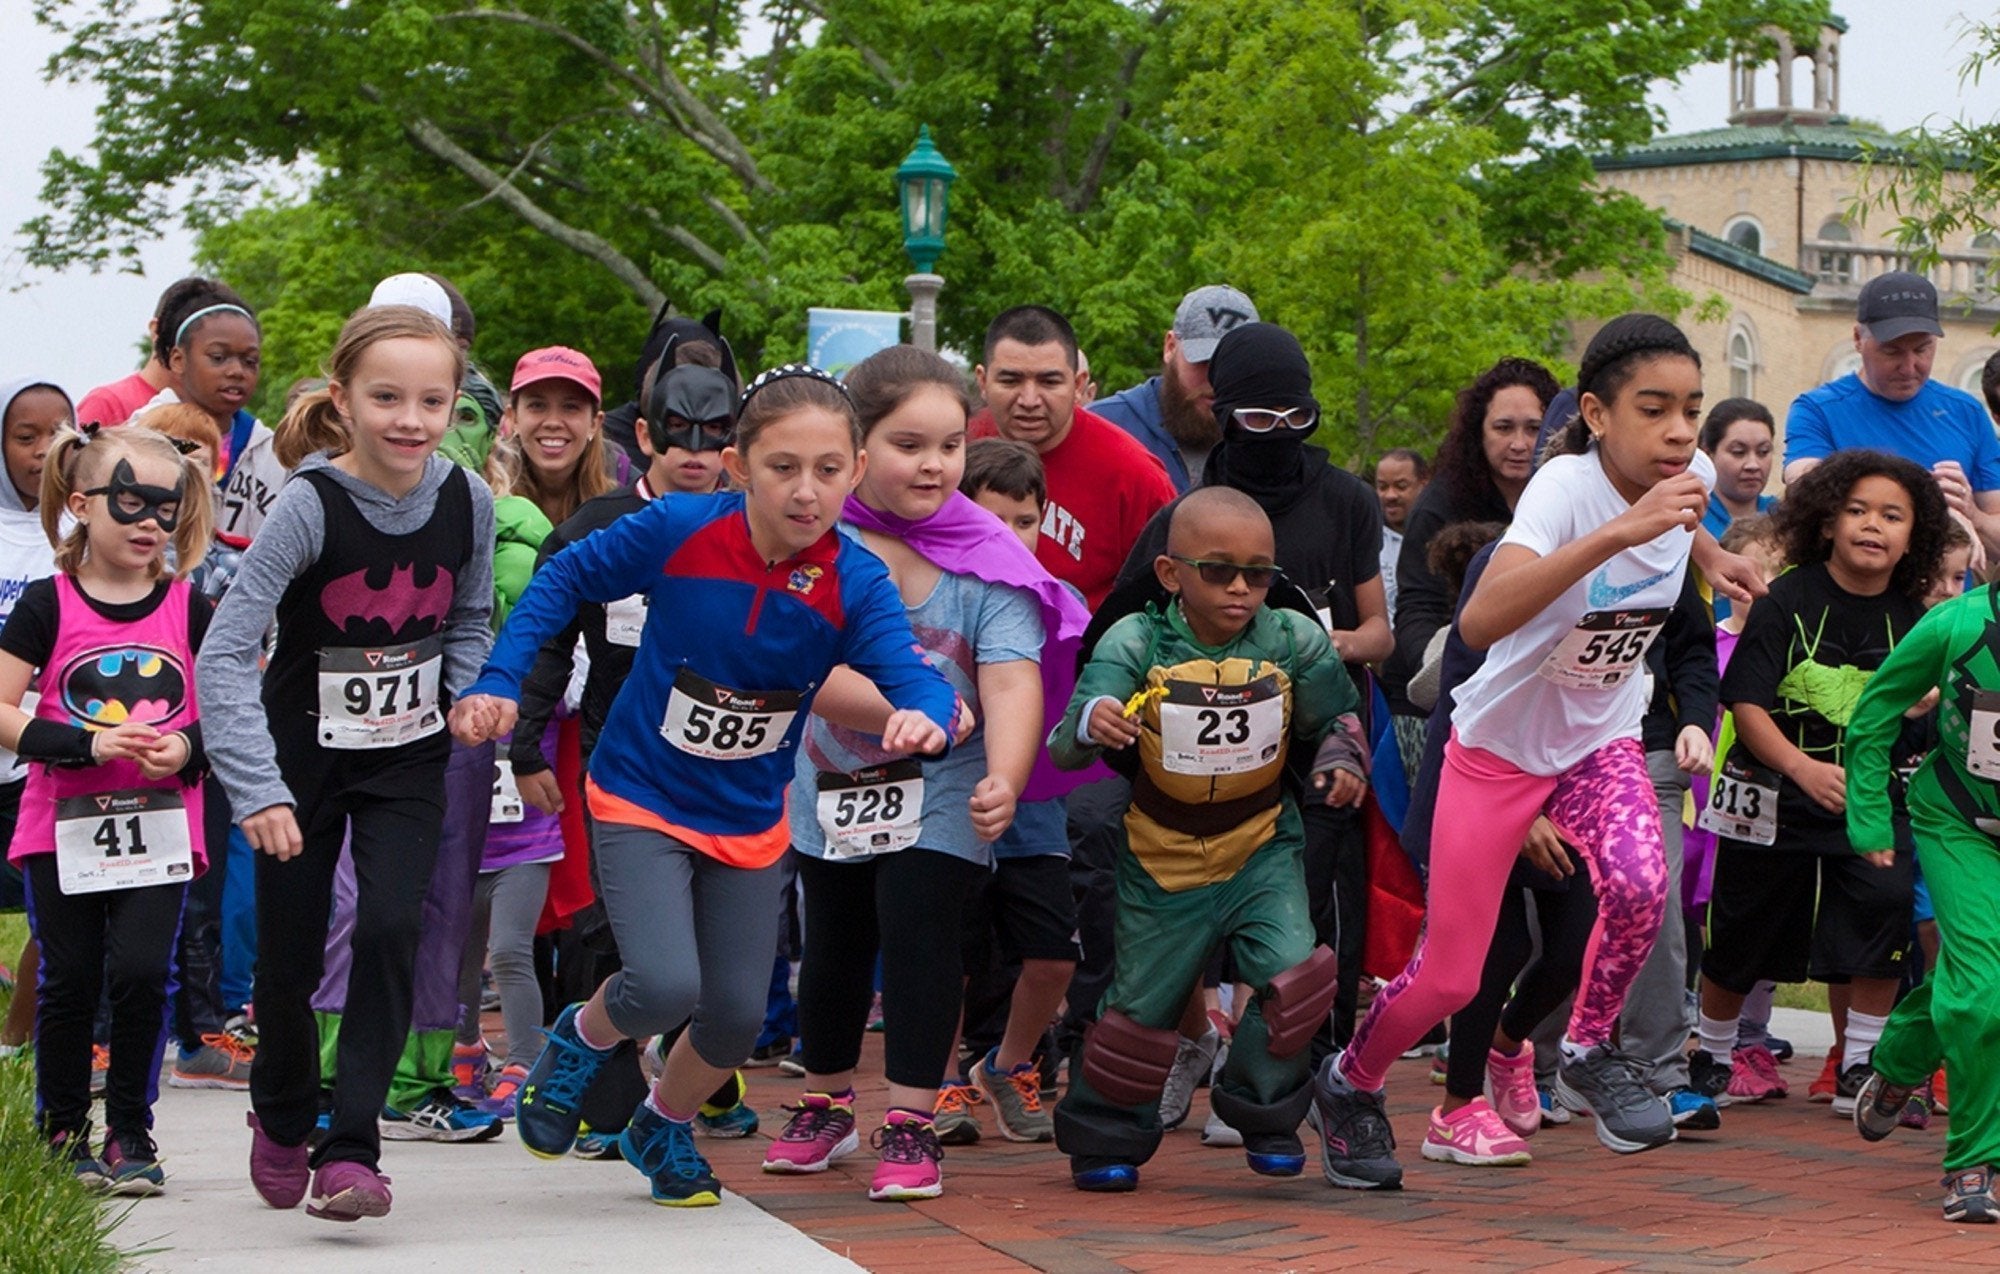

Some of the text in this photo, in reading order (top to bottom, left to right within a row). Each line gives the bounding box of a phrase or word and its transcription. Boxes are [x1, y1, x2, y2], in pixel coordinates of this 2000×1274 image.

[1205, 306, 1249, 330] VT
[1881, 291, 1928, 303] TESLA
[1039, 499, 1086, 562] ATE
[1577, 629, 1652, 666] 545
[344, 669, 422, 717] 971
[683, 704, 773, 751] 585
[1197, 709, 1250, 746] 23
[834, 785, 904, 828] 528
[1712, 777, 1761, 820] 813
[93, 815, 148, 858] 41
